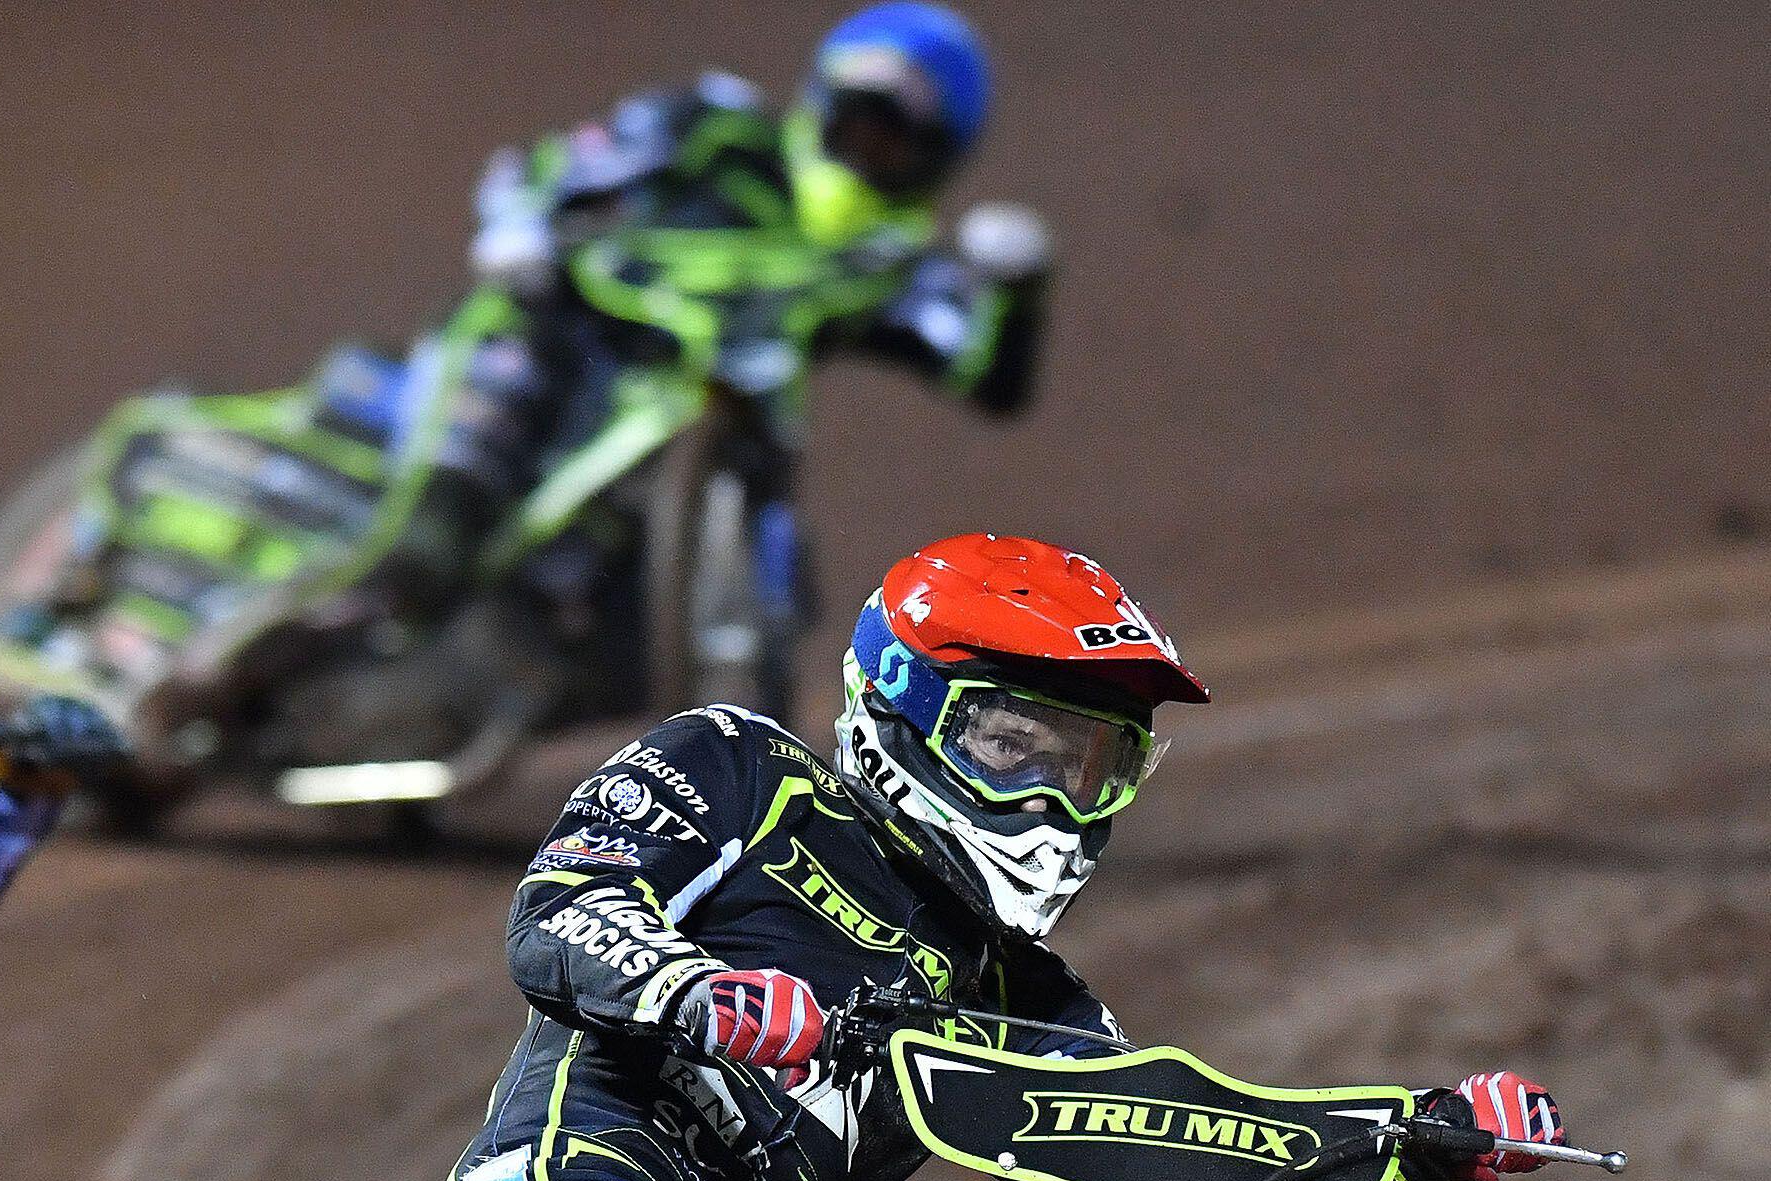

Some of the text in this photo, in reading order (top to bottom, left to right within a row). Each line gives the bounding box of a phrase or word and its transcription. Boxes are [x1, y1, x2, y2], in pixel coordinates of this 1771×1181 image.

[538, 906, 660, 977] SHOCKS
[801, 872, 905, 946] TRU
[1050, 1101, 1300, 1160] TRU MIX
